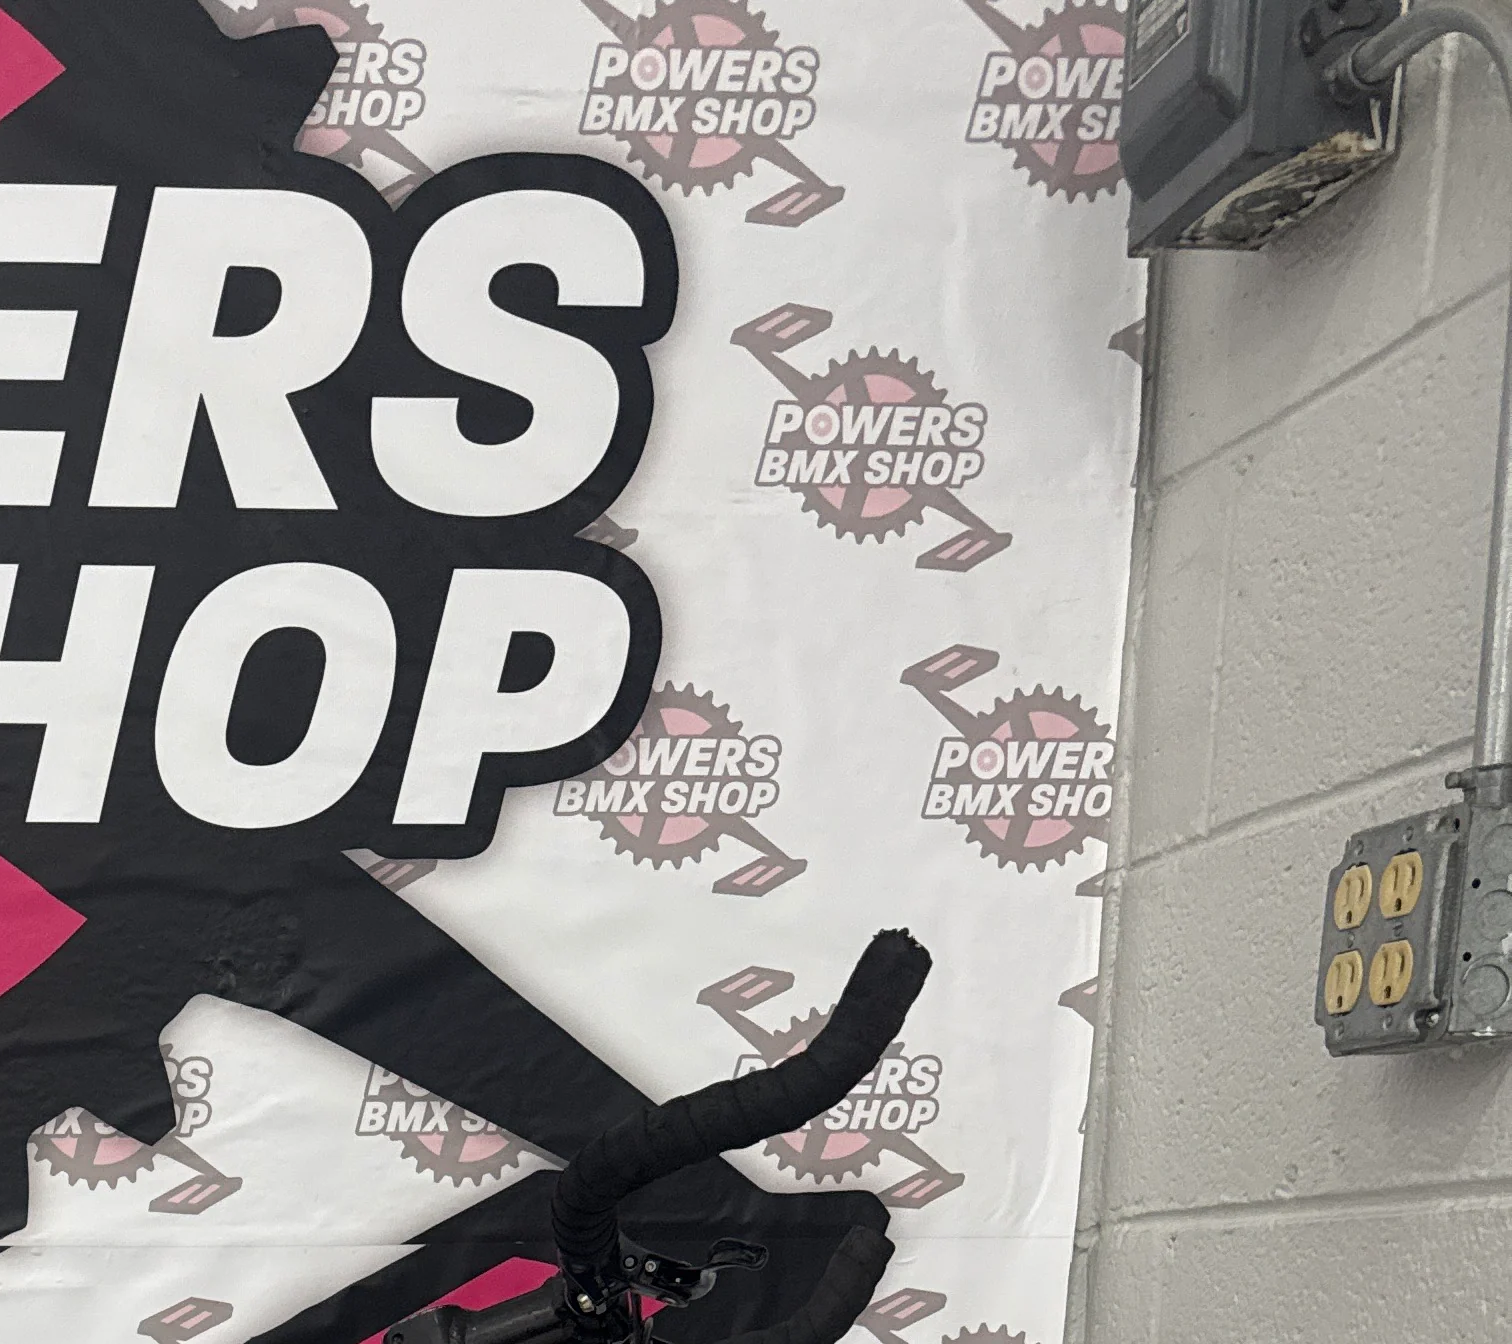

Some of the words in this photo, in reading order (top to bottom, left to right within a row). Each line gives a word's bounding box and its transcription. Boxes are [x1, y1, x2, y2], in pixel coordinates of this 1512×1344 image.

[334, 43, 425, 84] ERS
[594, 48, 815, 93] POWERS
[982, 57, 1122, 99] POWE
[584, 95, 685, 132] BMX
[692, 98, 811, 135] SHOP
[969, 104, 1071, 140] BMX
[770, 405, 982, 446] POWERS
[760, 450, 858, 484] BMX
[864, 451, 980, 485] SHOP
[604, 739, 778, 776] OWERS
[934, 743, 1115, 780] POWER
[557, 782, 653, 814] BMX
[661, 782, 776, 814] SHOP
[926, 785, 1014, 816] BMX
[1025, 785, 1112, 816] SHO
[364, 1101, 455, 1132] BMX
[824, 1099, 938, 1130] SHOP
